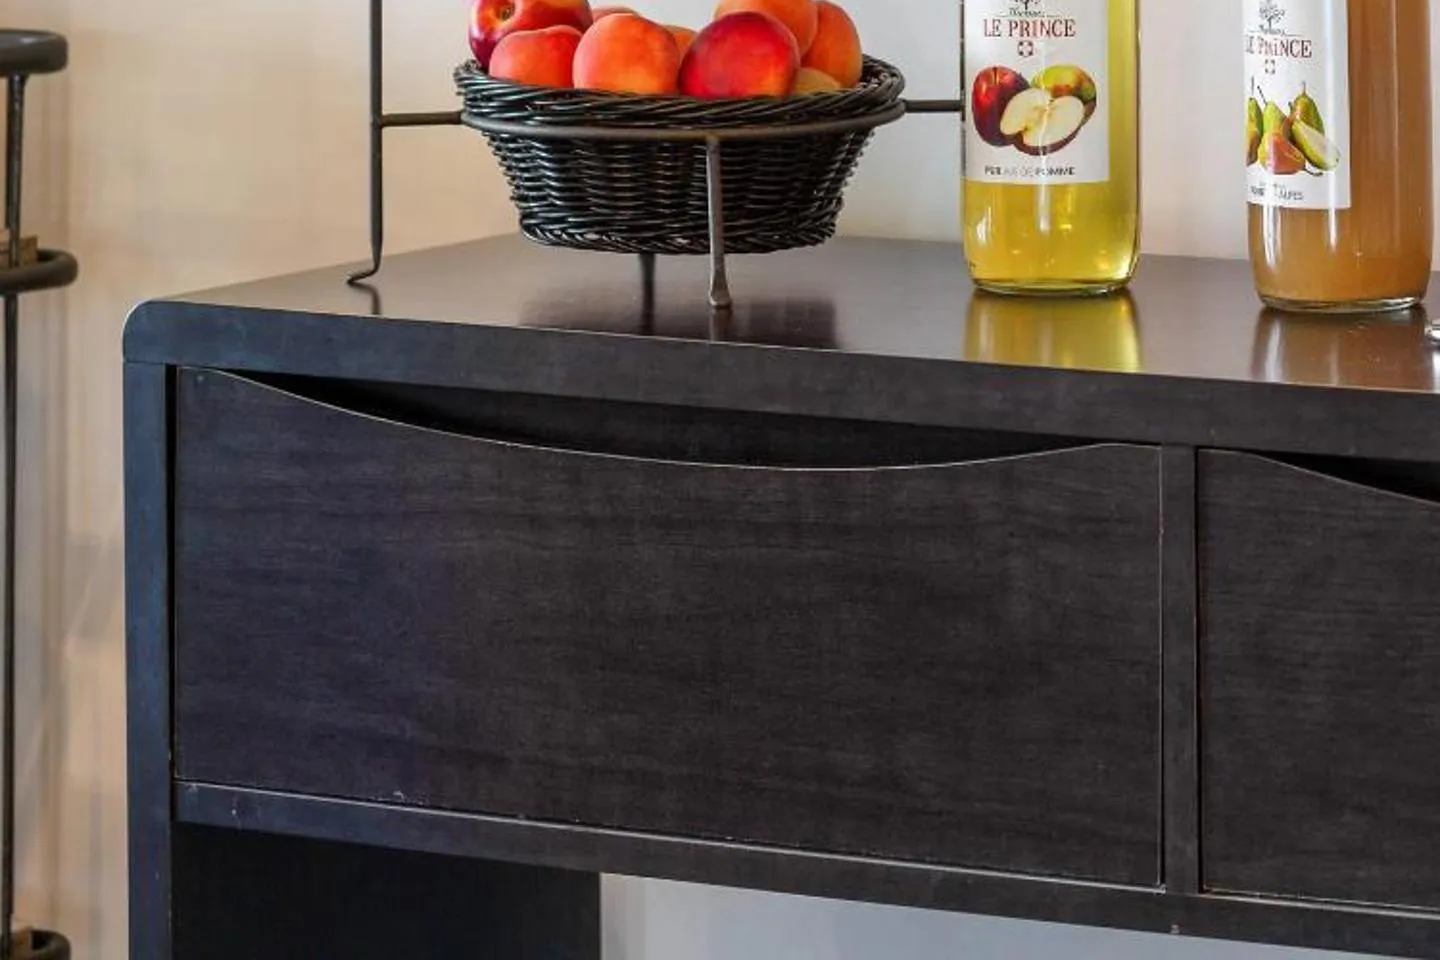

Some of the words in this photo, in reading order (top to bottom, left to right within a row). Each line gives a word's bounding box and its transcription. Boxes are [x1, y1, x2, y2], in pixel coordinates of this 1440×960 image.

[984, 18, 1002, 38] LE
[1008, 18, 1077, 39] PRINCE
[1257, 36, 1313, 58] PRINCE
